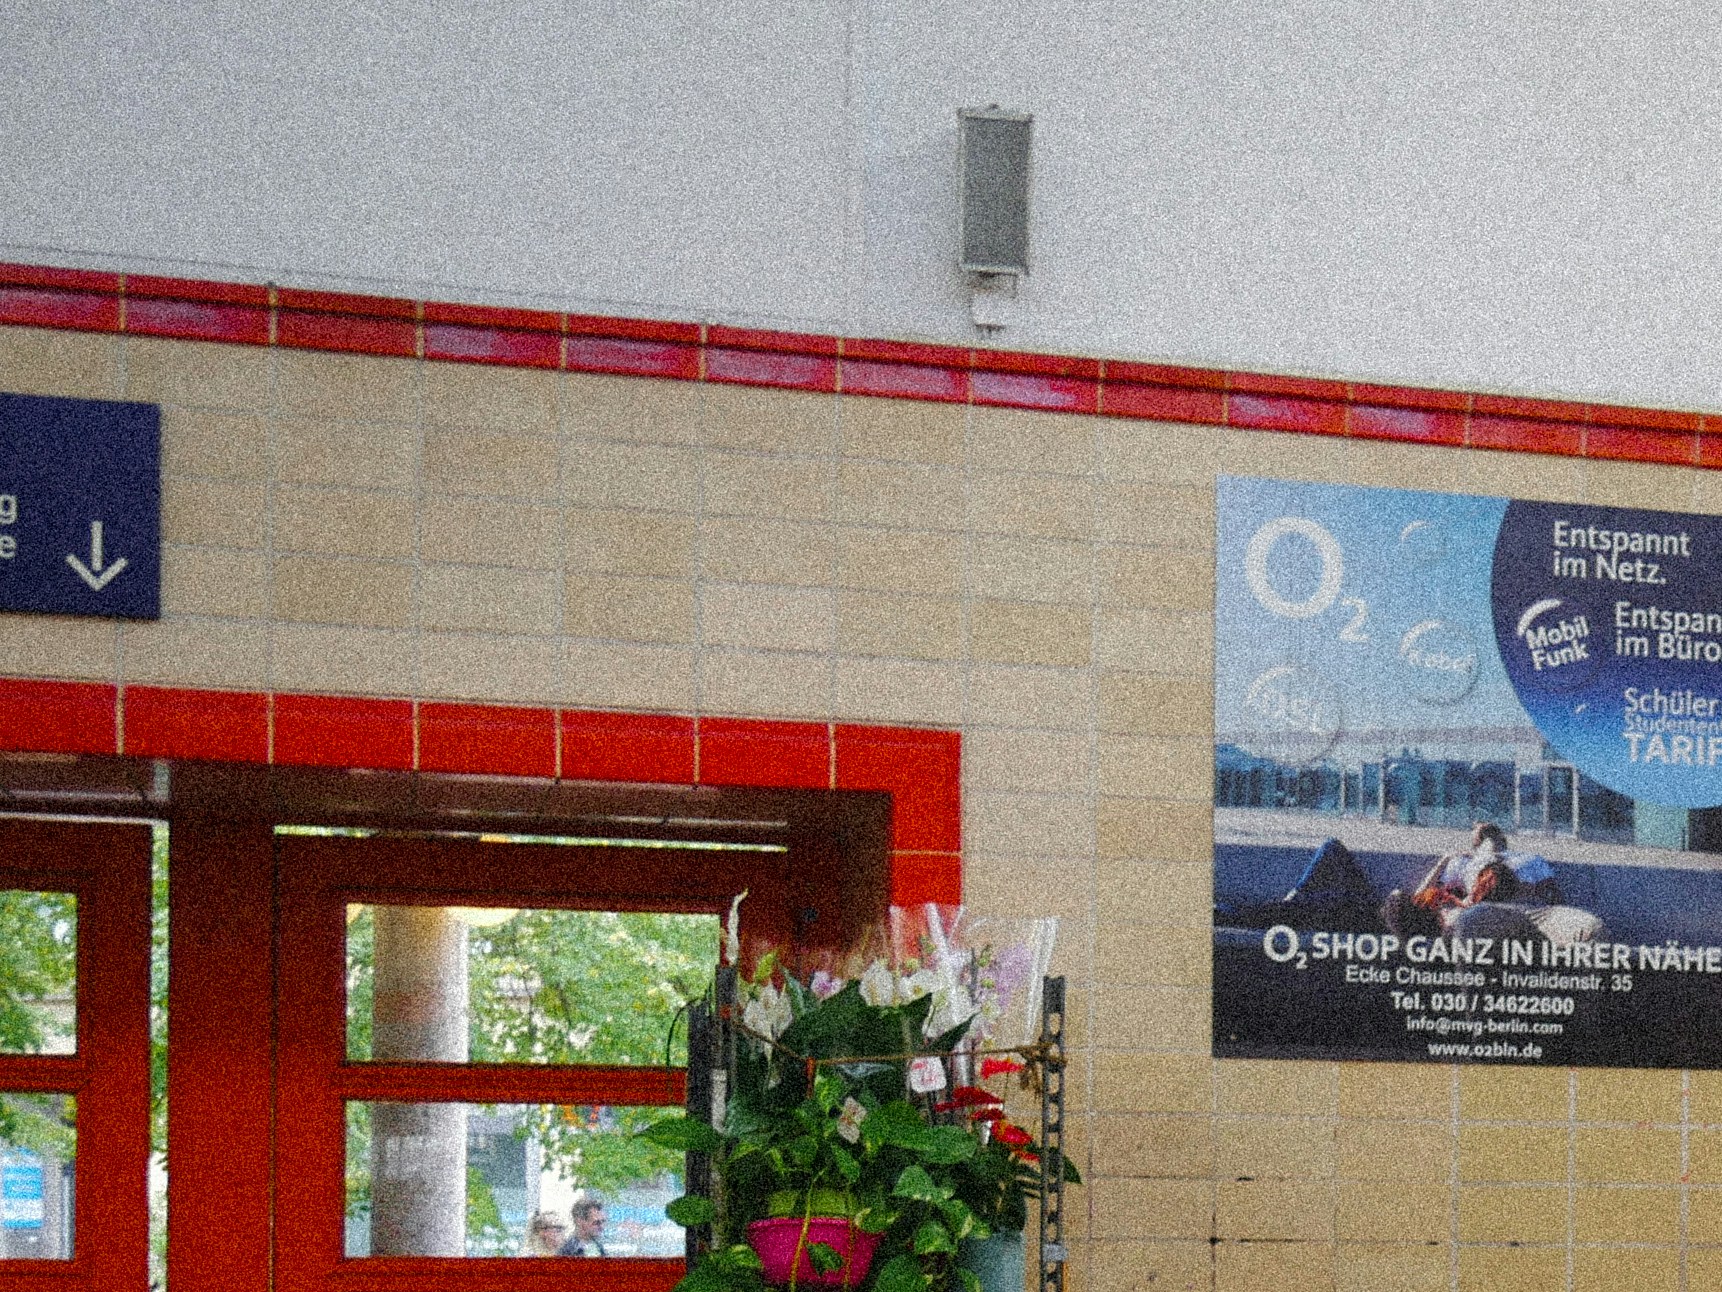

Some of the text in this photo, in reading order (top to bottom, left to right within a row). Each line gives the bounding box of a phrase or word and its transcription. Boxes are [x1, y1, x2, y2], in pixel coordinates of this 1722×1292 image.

[1553, 520, 1692, 563] Entspannt
[1553, 551, 1667, 585] im Netz.
[1525, 616, 1591, 650] Mobil
[1615, 629, 1649, 657] im
[1532, 641, 1591, 671] Funk
[1624, 686, 1719, 717] Schüler
[1624, 711, 1720, 736] Studenten
[1312, 931, 1400, 961] SHOP
[1405, 935, 1495, 966] GANZ
[1501, 938, 1534, 967] IN
[1540, 940, 1632, 971] IHRER
[1639, 939, 1722, 973] NÄHE
[1346, 964, 1391, 984] Ecke
[1396, 966, 1486, 987] Chaussee
[1501, 970, 1605, 991] Invalidenstr.
[1611, 974, 1634, 993] 35
[1389, 991, 1576, 1016] Tel. 030 / 34622600
[1406, 1014, 1564, 1036] info@mvg-berlin.com
